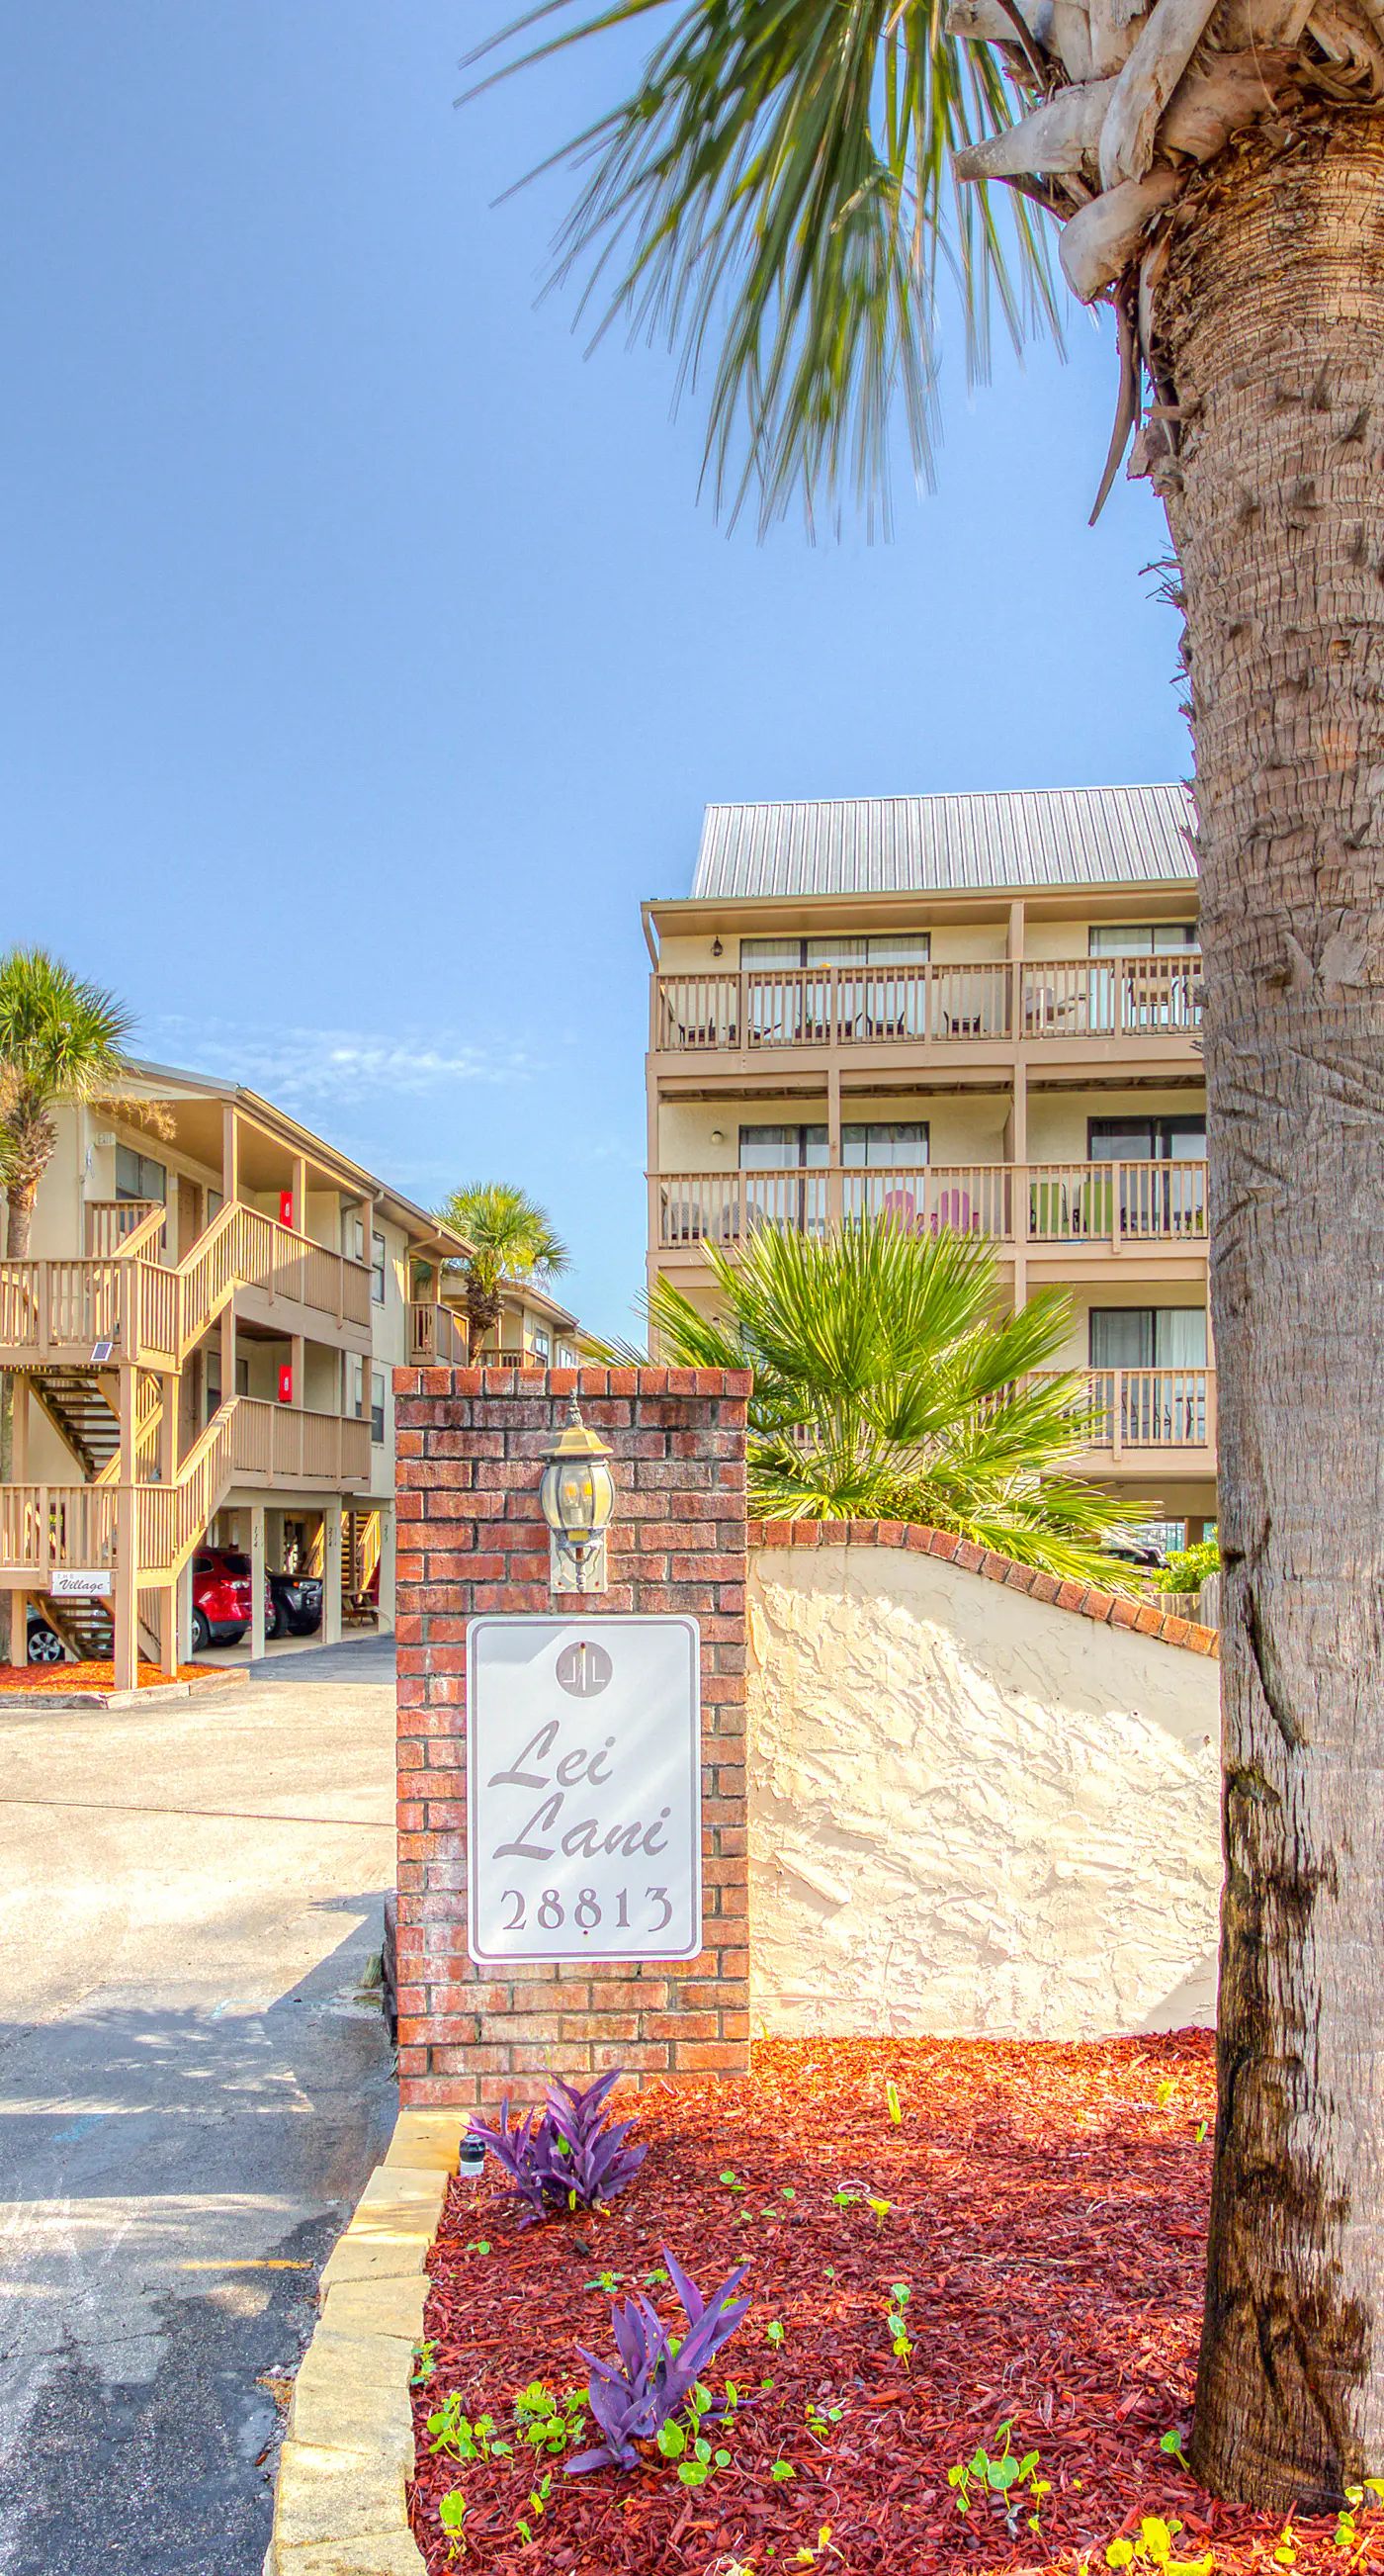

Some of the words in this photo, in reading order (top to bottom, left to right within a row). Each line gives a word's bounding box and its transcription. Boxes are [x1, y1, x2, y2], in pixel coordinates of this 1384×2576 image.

[59, 1579, 103, 1592] Village
[487, 1720, 616, 1789] Lei
[492, 1792, 671, 1861] Lani
[500, 1887, 673, 1932] 28813
